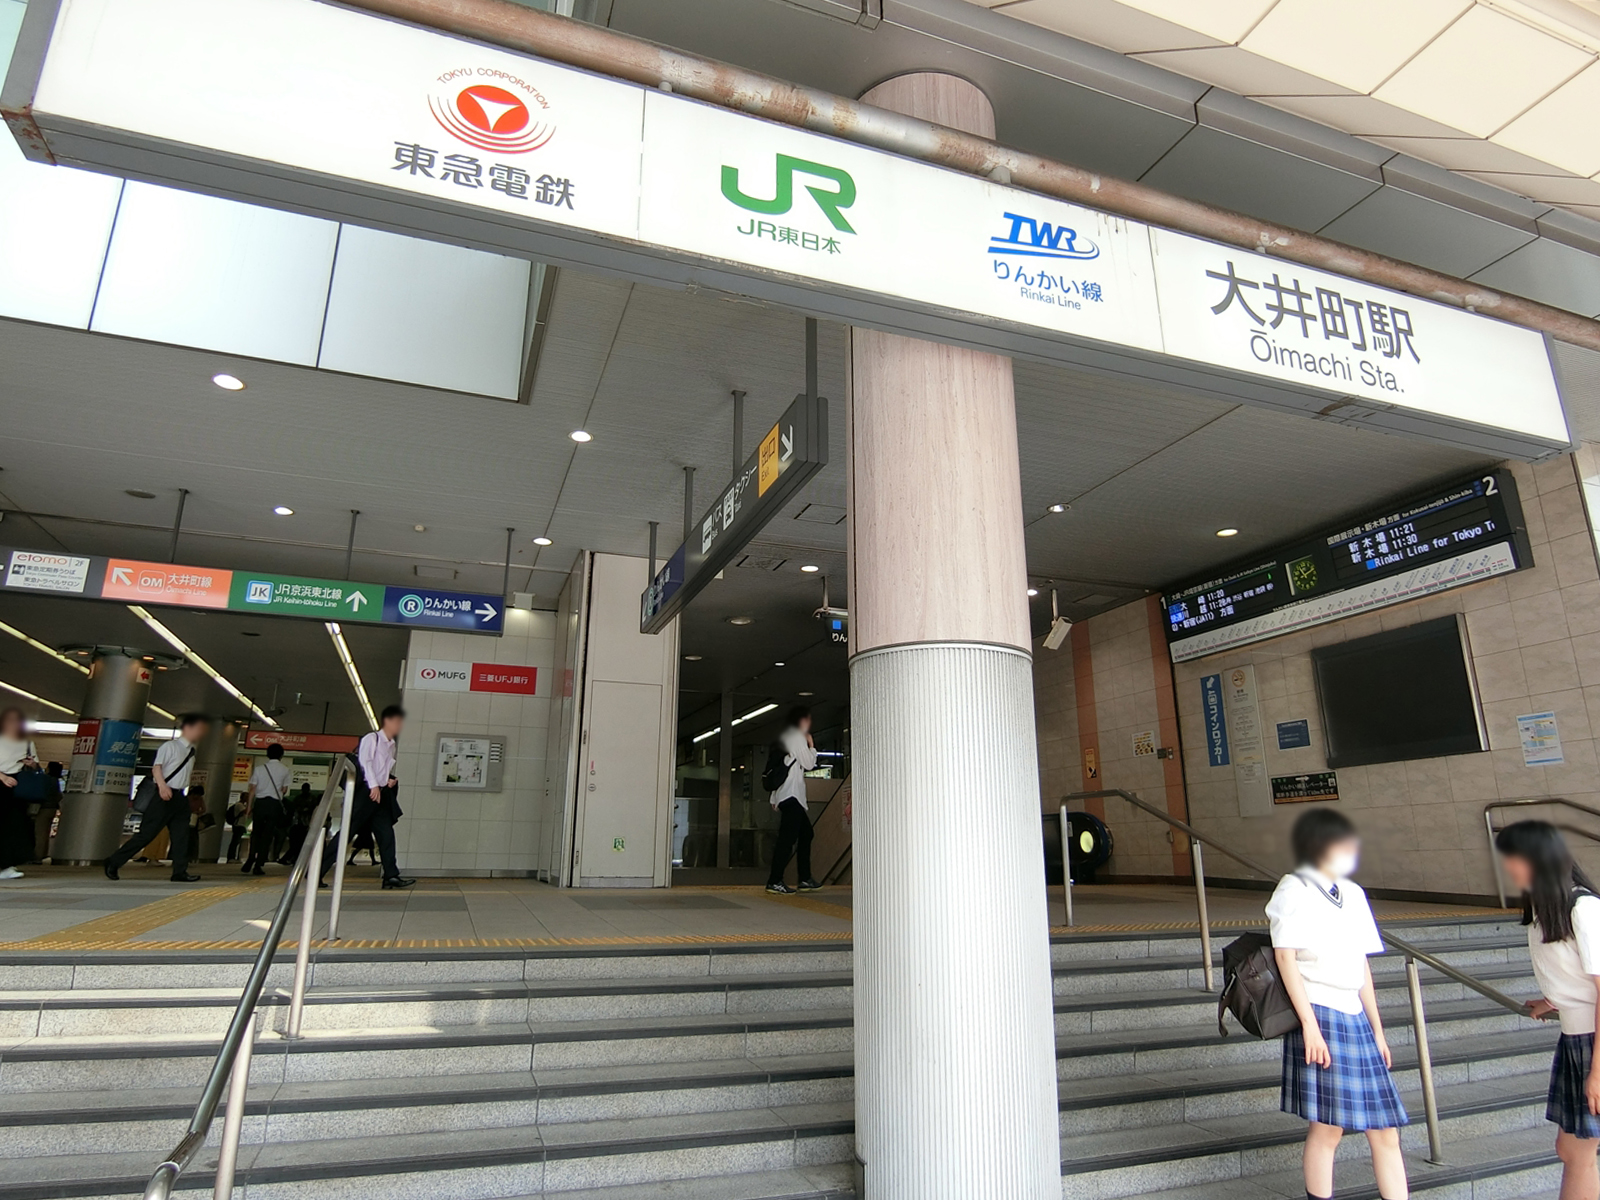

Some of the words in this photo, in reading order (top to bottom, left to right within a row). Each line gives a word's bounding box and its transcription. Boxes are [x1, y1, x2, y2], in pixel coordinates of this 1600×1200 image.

[436, 67, 473, 84] TOKYU
[477, 67, 550, 110] CORPORATION
[390, 141, 575, 210] 東急電鉄
[721, 153, 857, 235] JR
[737, 218, 842, 255] JR東日本
[993, 258, 1104, 303] りんかい線
[1020, 286, 1055, 305] Rinkai
[1057, 293, 1082, 311] Line
[1205, 261, 1421, 365] 大井町駅
[1250, 328, 1353, 382] Ōimachi
[1359, 360, 1405, 394] Sta.
[761, 437, 776, 468] 出口
[735, 465, 757, 501] タクシー
[1482, 475, 1499, 497] 2
[1389, 523, 1414, 539] 11:21
[1374, 550, 1404, 568] Rinkai
[1406, 543, 1429, 557] Line
[1432, 537, 1449, 549] for
[1452, 526, 1482, 542] Tokyo
[1392, 534, 1418, 550] 11:30
[17, 553, 68, 566] etomo
[141, 576, 162, 587] OM
[167, 573, 212, 588] 大井町線
[252, 586, 268, 597] JK
[274, 583, 343, 600] JR京浜東北線
[407, 601, 416, 611] R
[424, 597, 472, 611] りんかい線
[1160, 596, 1167, 610] 1
[423, 608, 441, 617] Rinkai
[441, 610, 454, 618] Line
[438, 671, 466, 680] MUFG
[479, 673, 529, 685] 三菱UFJ銀行
[1209, 705, 1223, 764] コインロッカー
